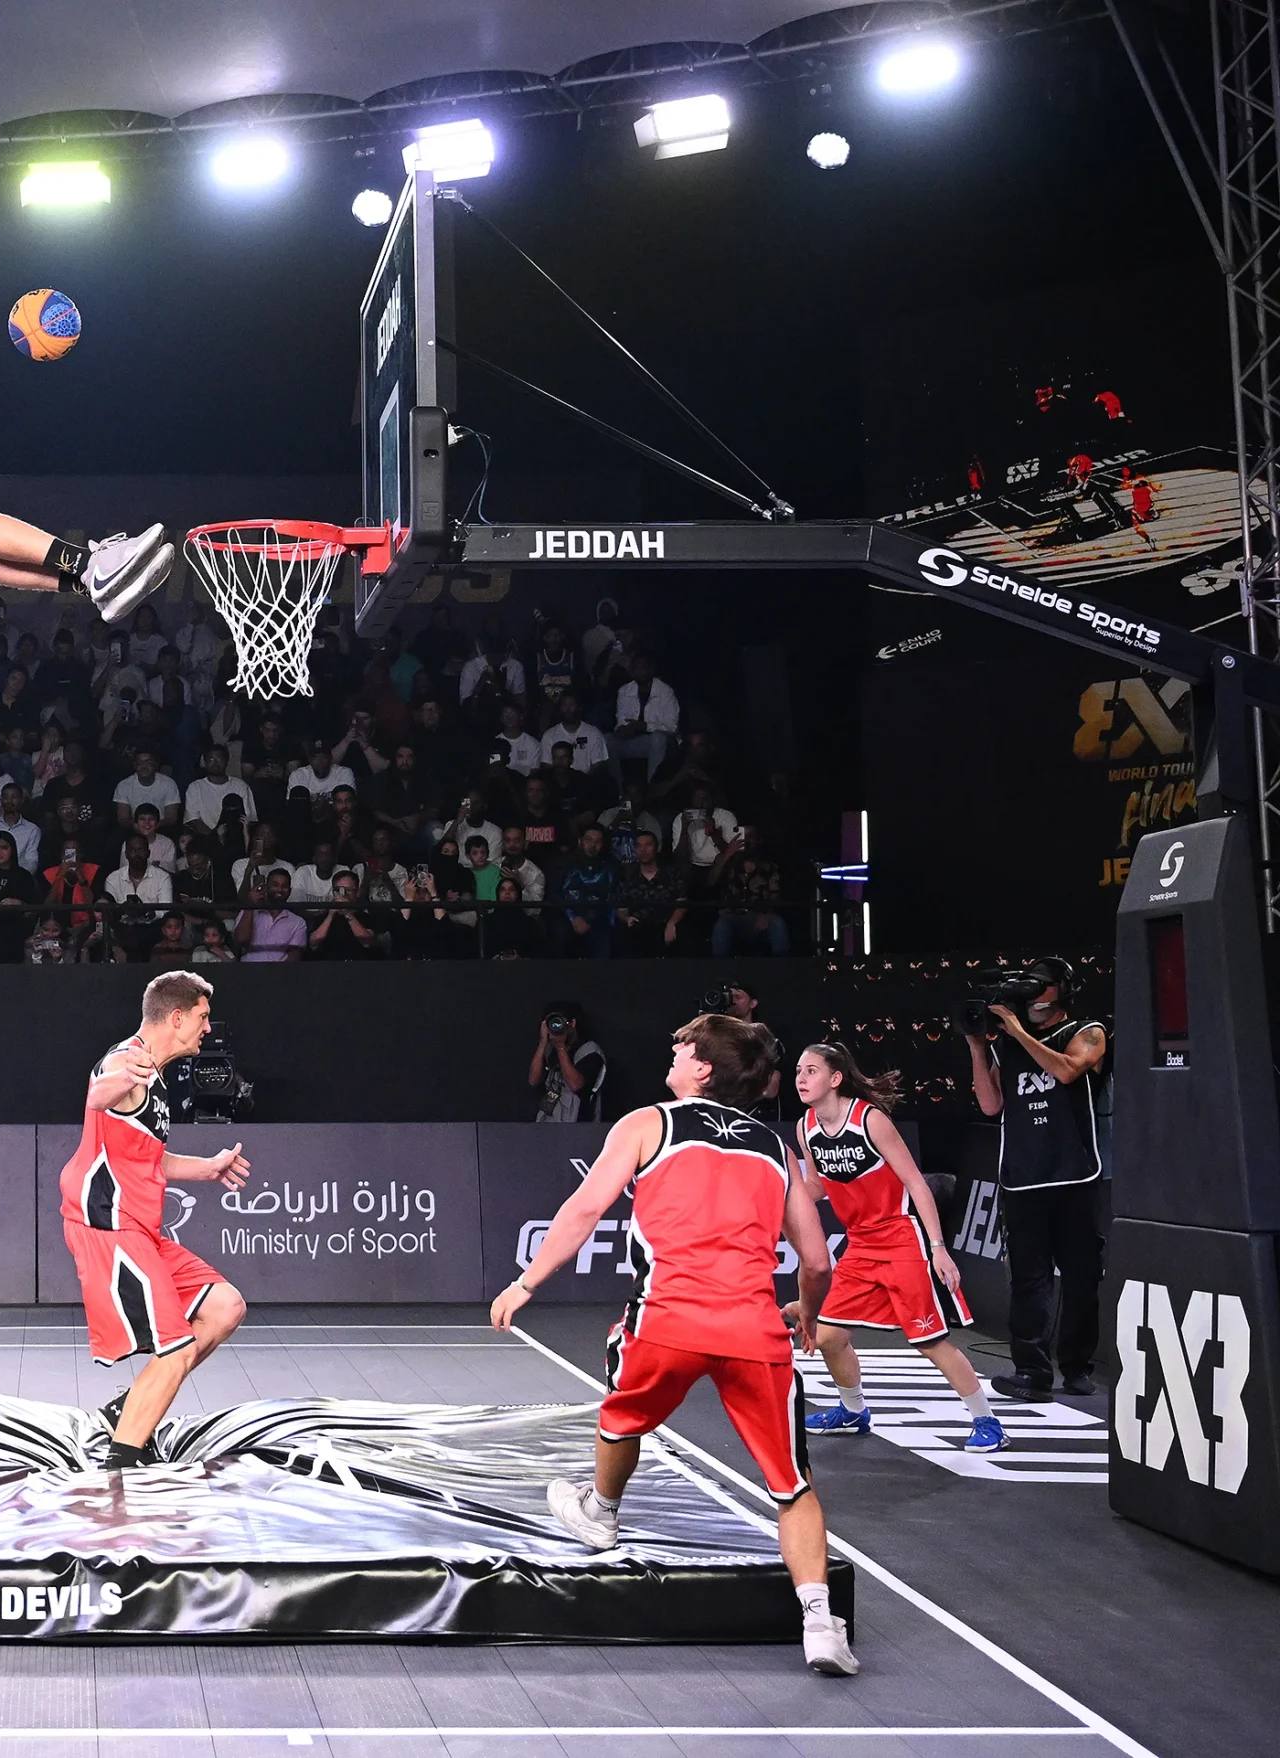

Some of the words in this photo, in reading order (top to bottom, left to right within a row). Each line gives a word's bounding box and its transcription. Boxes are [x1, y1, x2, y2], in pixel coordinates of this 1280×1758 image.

[529, 530, 665, 559] JEDDAH
[970, 566, 1073, 615] Schelde
[1077, 602, 1161, 645] Sports
[1095, 626, 1124, 642] Superior
[1124, 636, 1134, 646] by
[1133, 639, 1157, 653] Design
[1108, 766, 1159, 783] WORLD
[1028, 1100, 1049, 1110] FIBA
[1033, 1116, 1048, 1125] 224
[811, 1144, 866, 1162] Dunking
[819, 1159, 858, 1174] Devils
[220, 1180, 339, 1222] الرياضة
[352, 1180, 436, 1222] وزارة
[221, 1228, 320, 1260] Ministry
[327, 1227, 356, 1254] of
[362, 1227, 438, 1260] Sport
[1, 1582, 123, 1621] DEVILS
